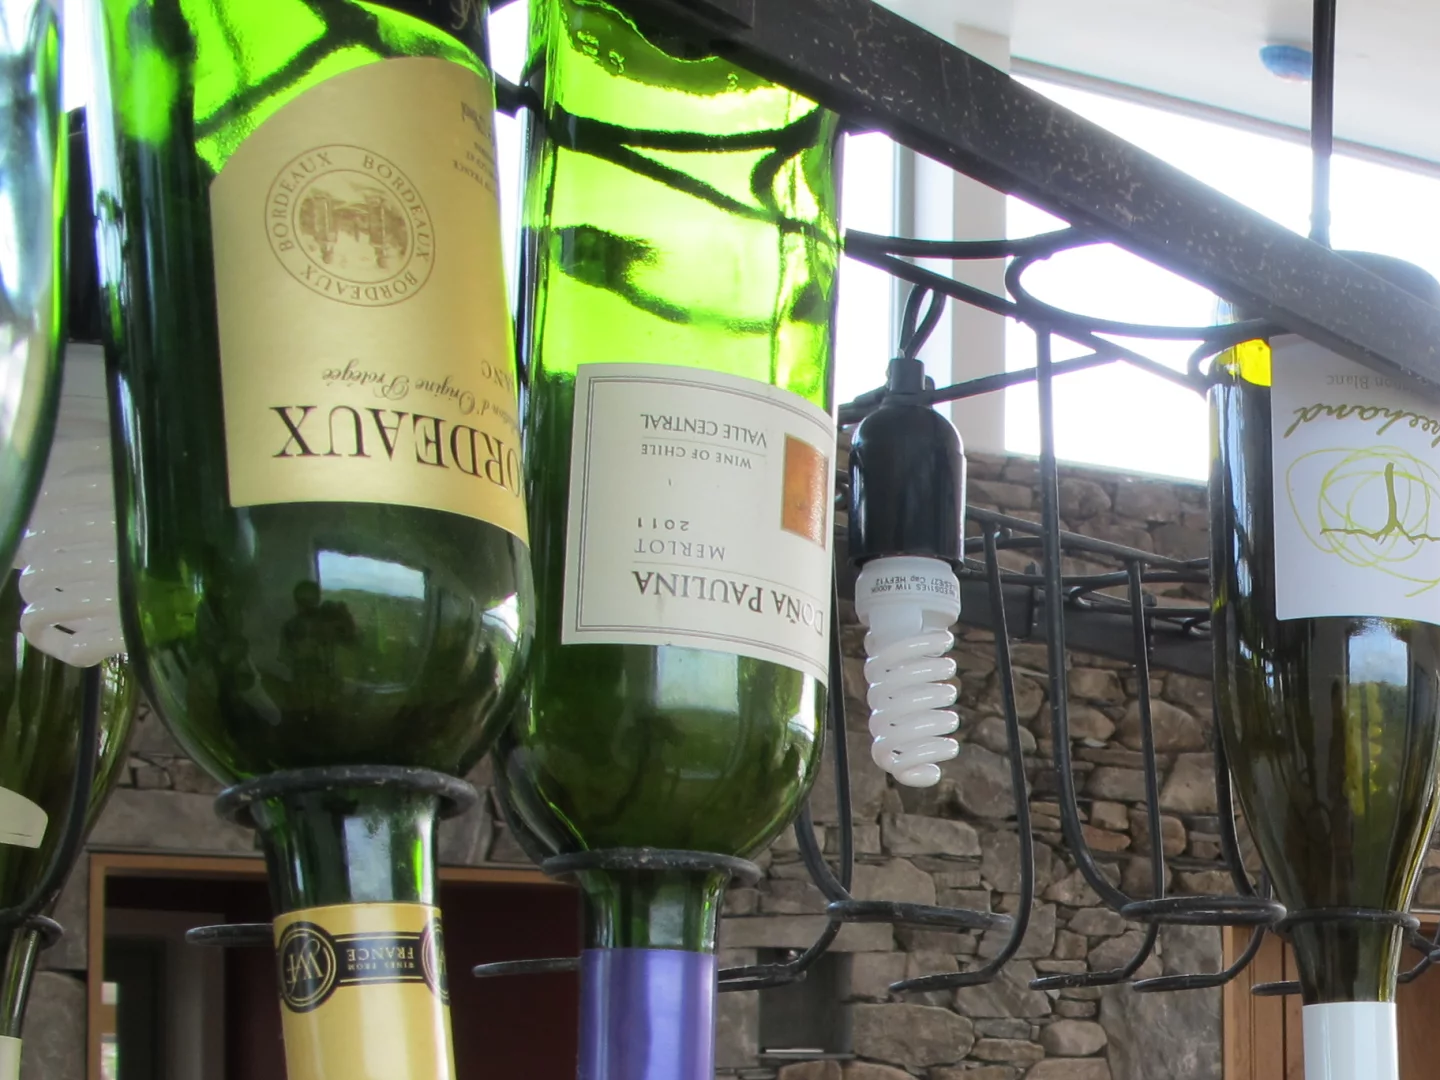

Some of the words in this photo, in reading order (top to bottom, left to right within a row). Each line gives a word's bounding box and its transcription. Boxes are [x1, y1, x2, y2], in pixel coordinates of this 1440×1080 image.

[270, 151, 333, 253] BORDEAUX
[361, 152, 432, 263] BORDEAUX
[301, 264, 418, 302] BORDEAUX
[1325, 374, 1370, 390] Blanc
[639, 413, 719, 437] CENTRAL
[722, 422, 767, 449] VALLE
[271, 406, 523, 501] ORDEAUX
[640, 443, 686, 459] CHILE
[690, 448, 710, 462] OF
[714, 451, 752, 470] WINE
[635, 516, 690, 532] 2011
[632, 537, 726, 562] MERLOT
[631, 570, 764, 614] PAULINA
[770, 589, 825, 638] DOÑA
[345, 946, 415, 963] FRANCE
[347, 962, 376, 971] FROM
[383, 961, 415, 969] WINES
